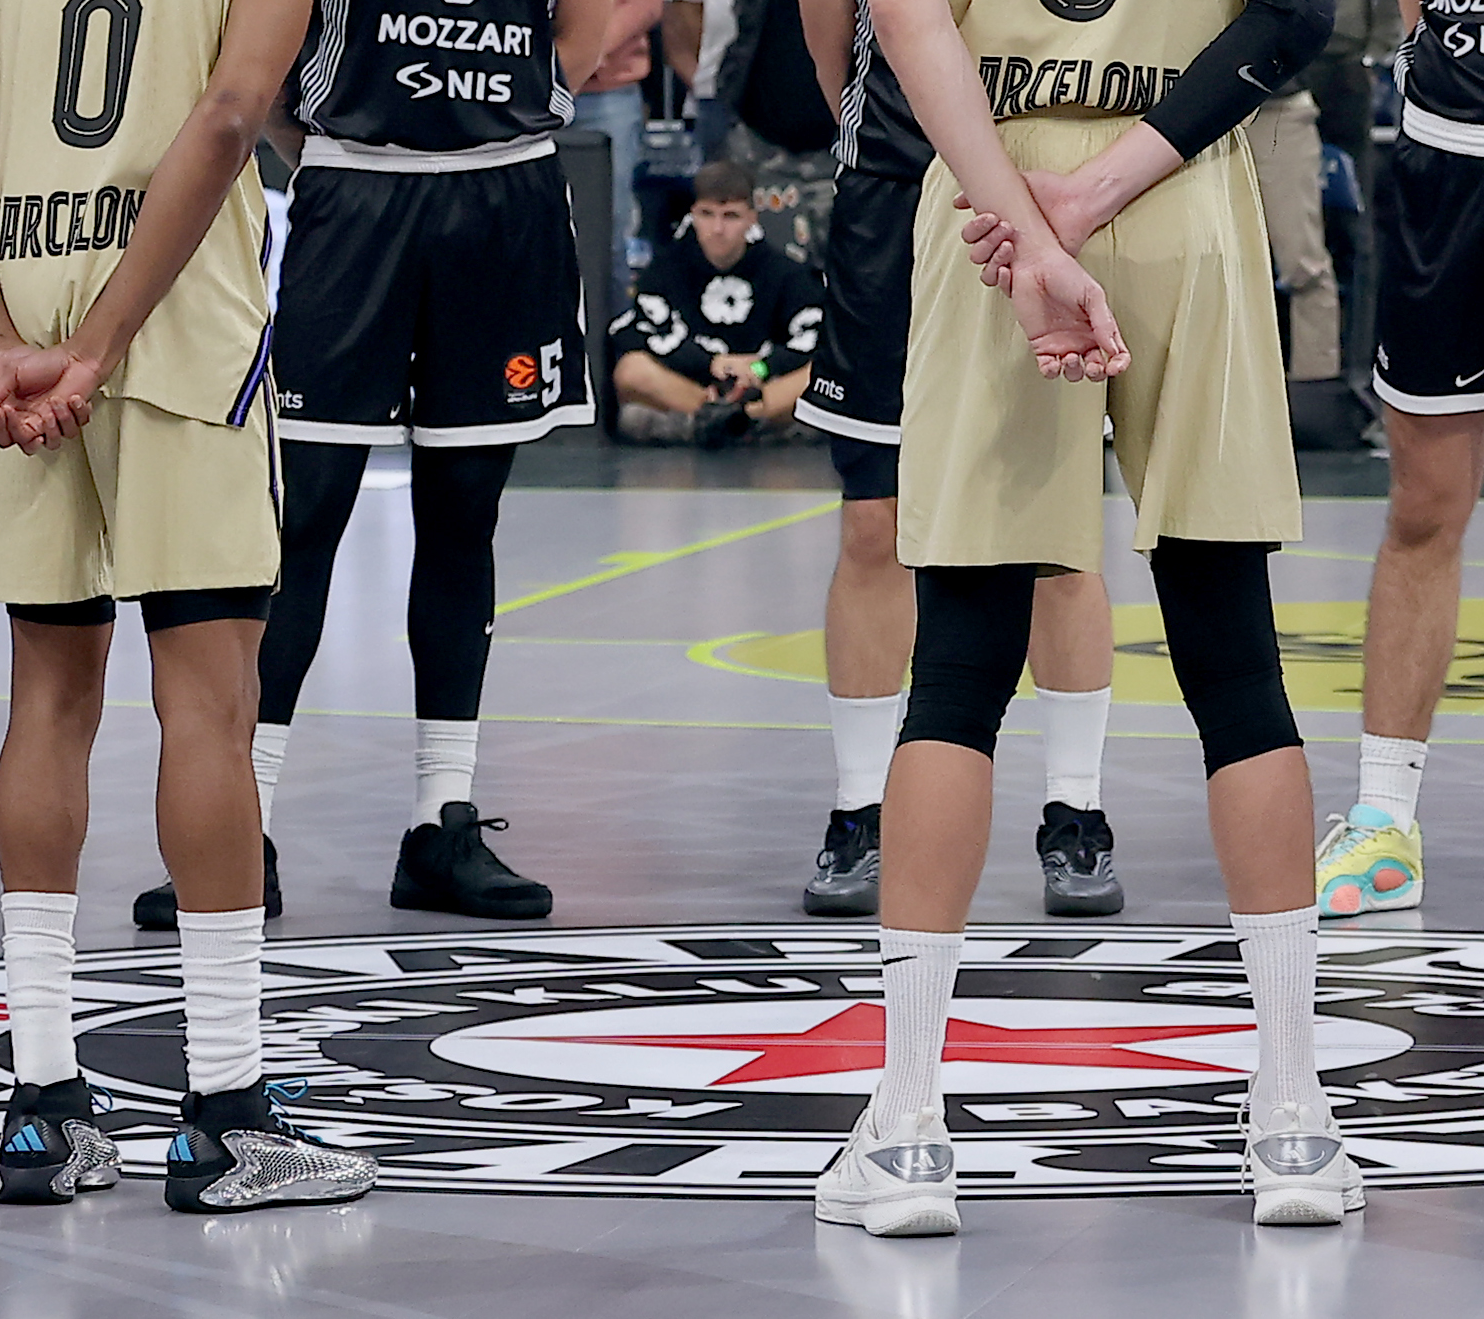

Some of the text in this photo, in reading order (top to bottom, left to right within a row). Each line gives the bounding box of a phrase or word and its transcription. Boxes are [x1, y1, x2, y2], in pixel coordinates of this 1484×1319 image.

[377, 13, 532, 57] MOZZART
[447, 69, 512, 102] NIS
[540, 341, 562, 408] 5
[814, 377, 845, 401] mts
